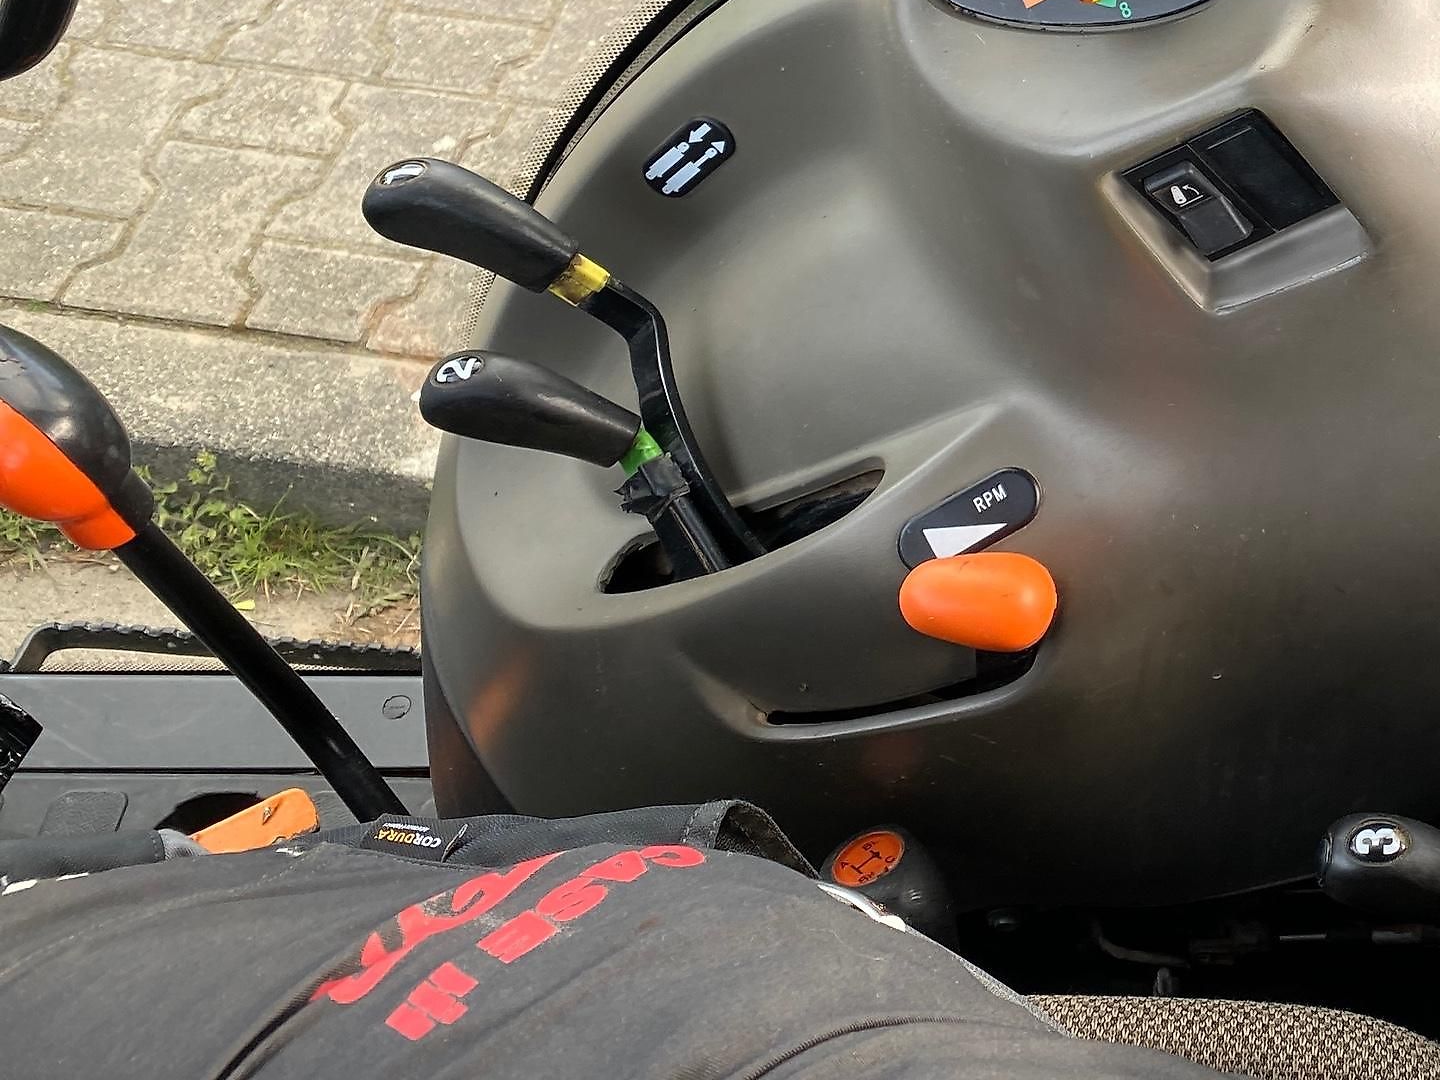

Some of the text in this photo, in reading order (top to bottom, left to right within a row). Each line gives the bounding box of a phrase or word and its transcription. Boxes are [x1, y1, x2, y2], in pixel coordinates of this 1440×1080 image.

[1119, 1, 1132, 19] 8
[436, 357, 479, 383] 2
[972, 483, 1008, 513] RPM
[378, 828, 442, 848] CORDURA
[1355, 827, 1402, 855] 3
